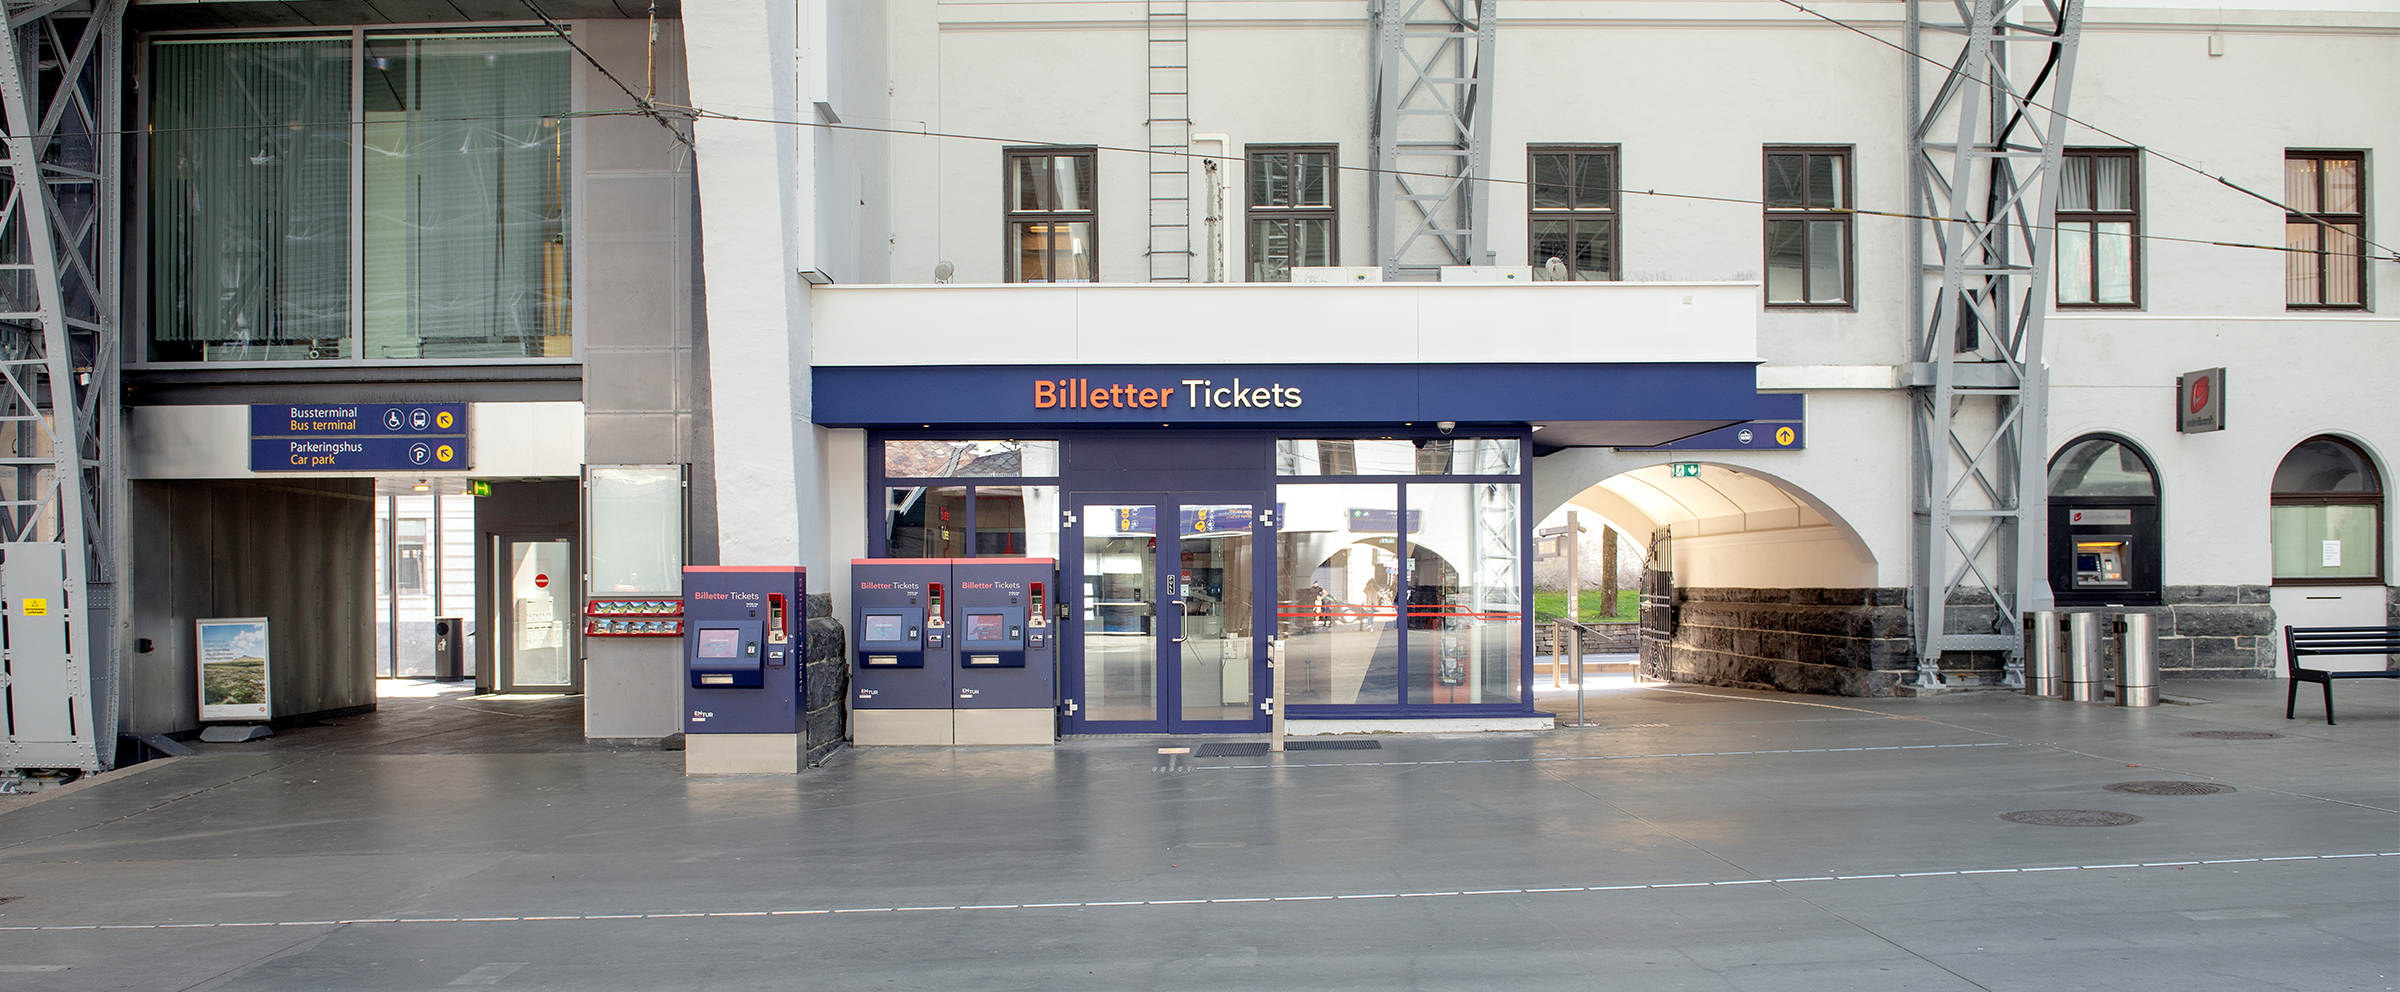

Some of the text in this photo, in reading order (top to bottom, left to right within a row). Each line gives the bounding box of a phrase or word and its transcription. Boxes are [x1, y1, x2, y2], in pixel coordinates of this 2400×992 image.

[1034, 377, 1302, 408] Billetter Tickets
[290, 407, 357, 418] Bussterminal
[290, 420, 356, 431] Bus terminal
[290, 441, 362, 454] Parkeringshus
[290, 454, 335, 467] Car park
[861, 581, 919, 590] Billetter Tickets
[962, 581, 1021, 590] Billetter Tickets
[694, 591, 760, 600] Billetter Tickets
